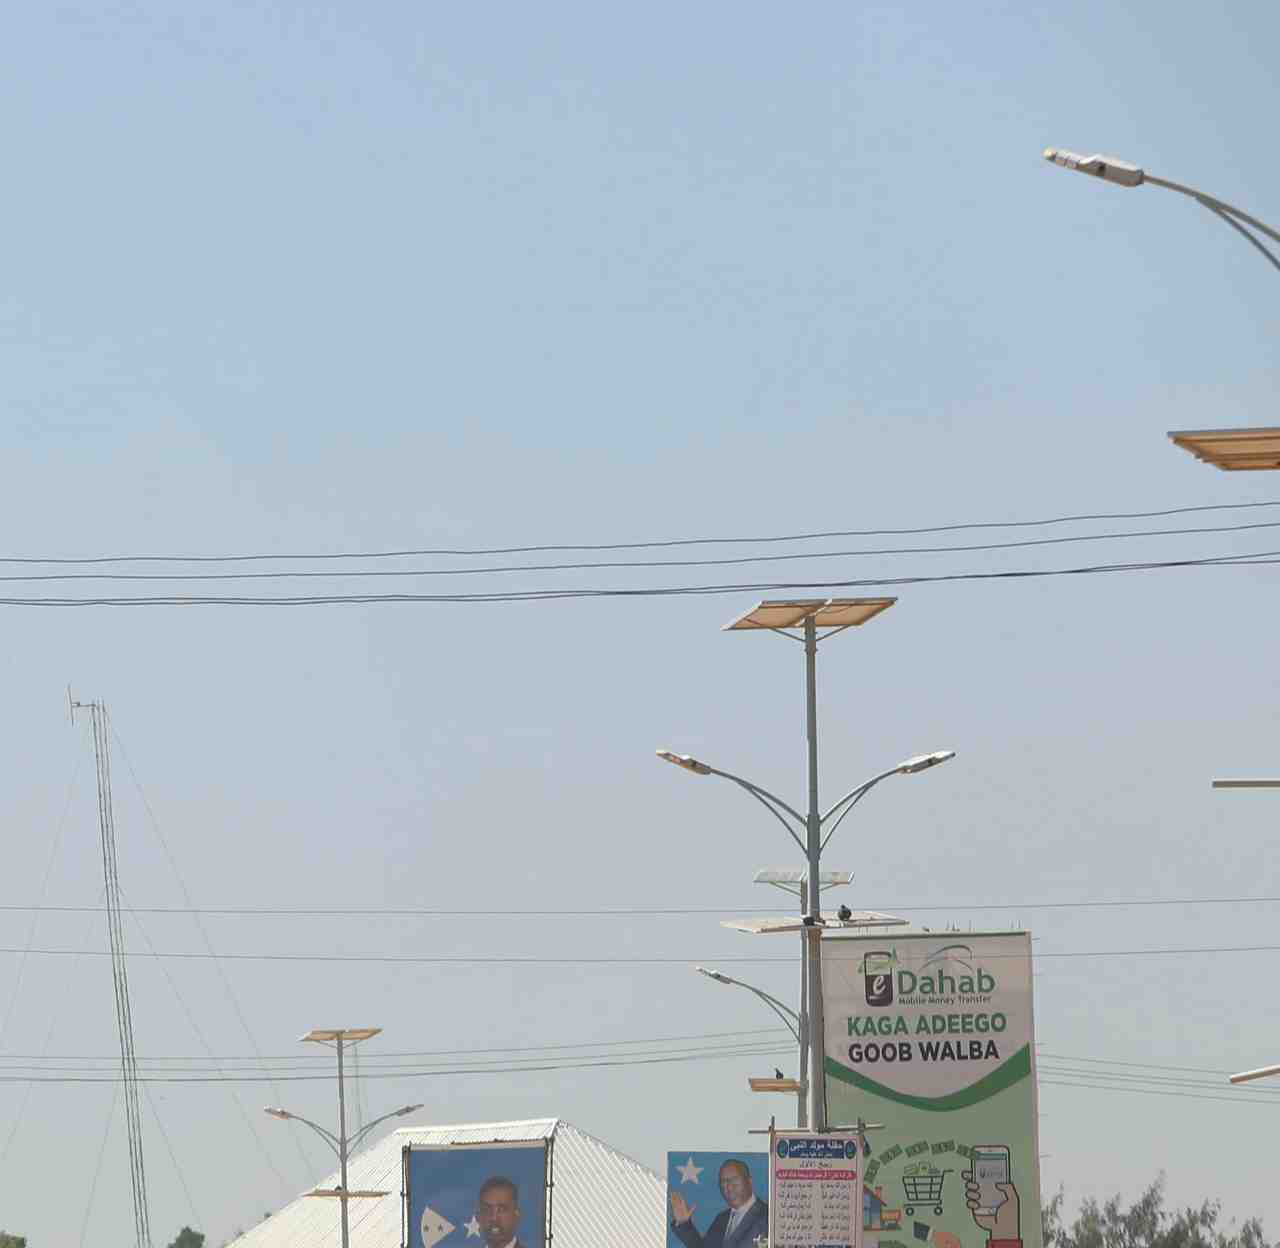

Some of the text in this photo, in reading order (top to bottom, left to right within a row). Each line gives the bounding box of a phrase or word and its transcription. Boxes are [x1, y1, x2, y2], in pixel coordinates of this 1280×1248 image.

[897, 968, 996, 995] Dahab
[847, 1012, 1007, 1036] KAGA ADEEGO
[848, 1039, 1000, 1063] GOOB WALBA
